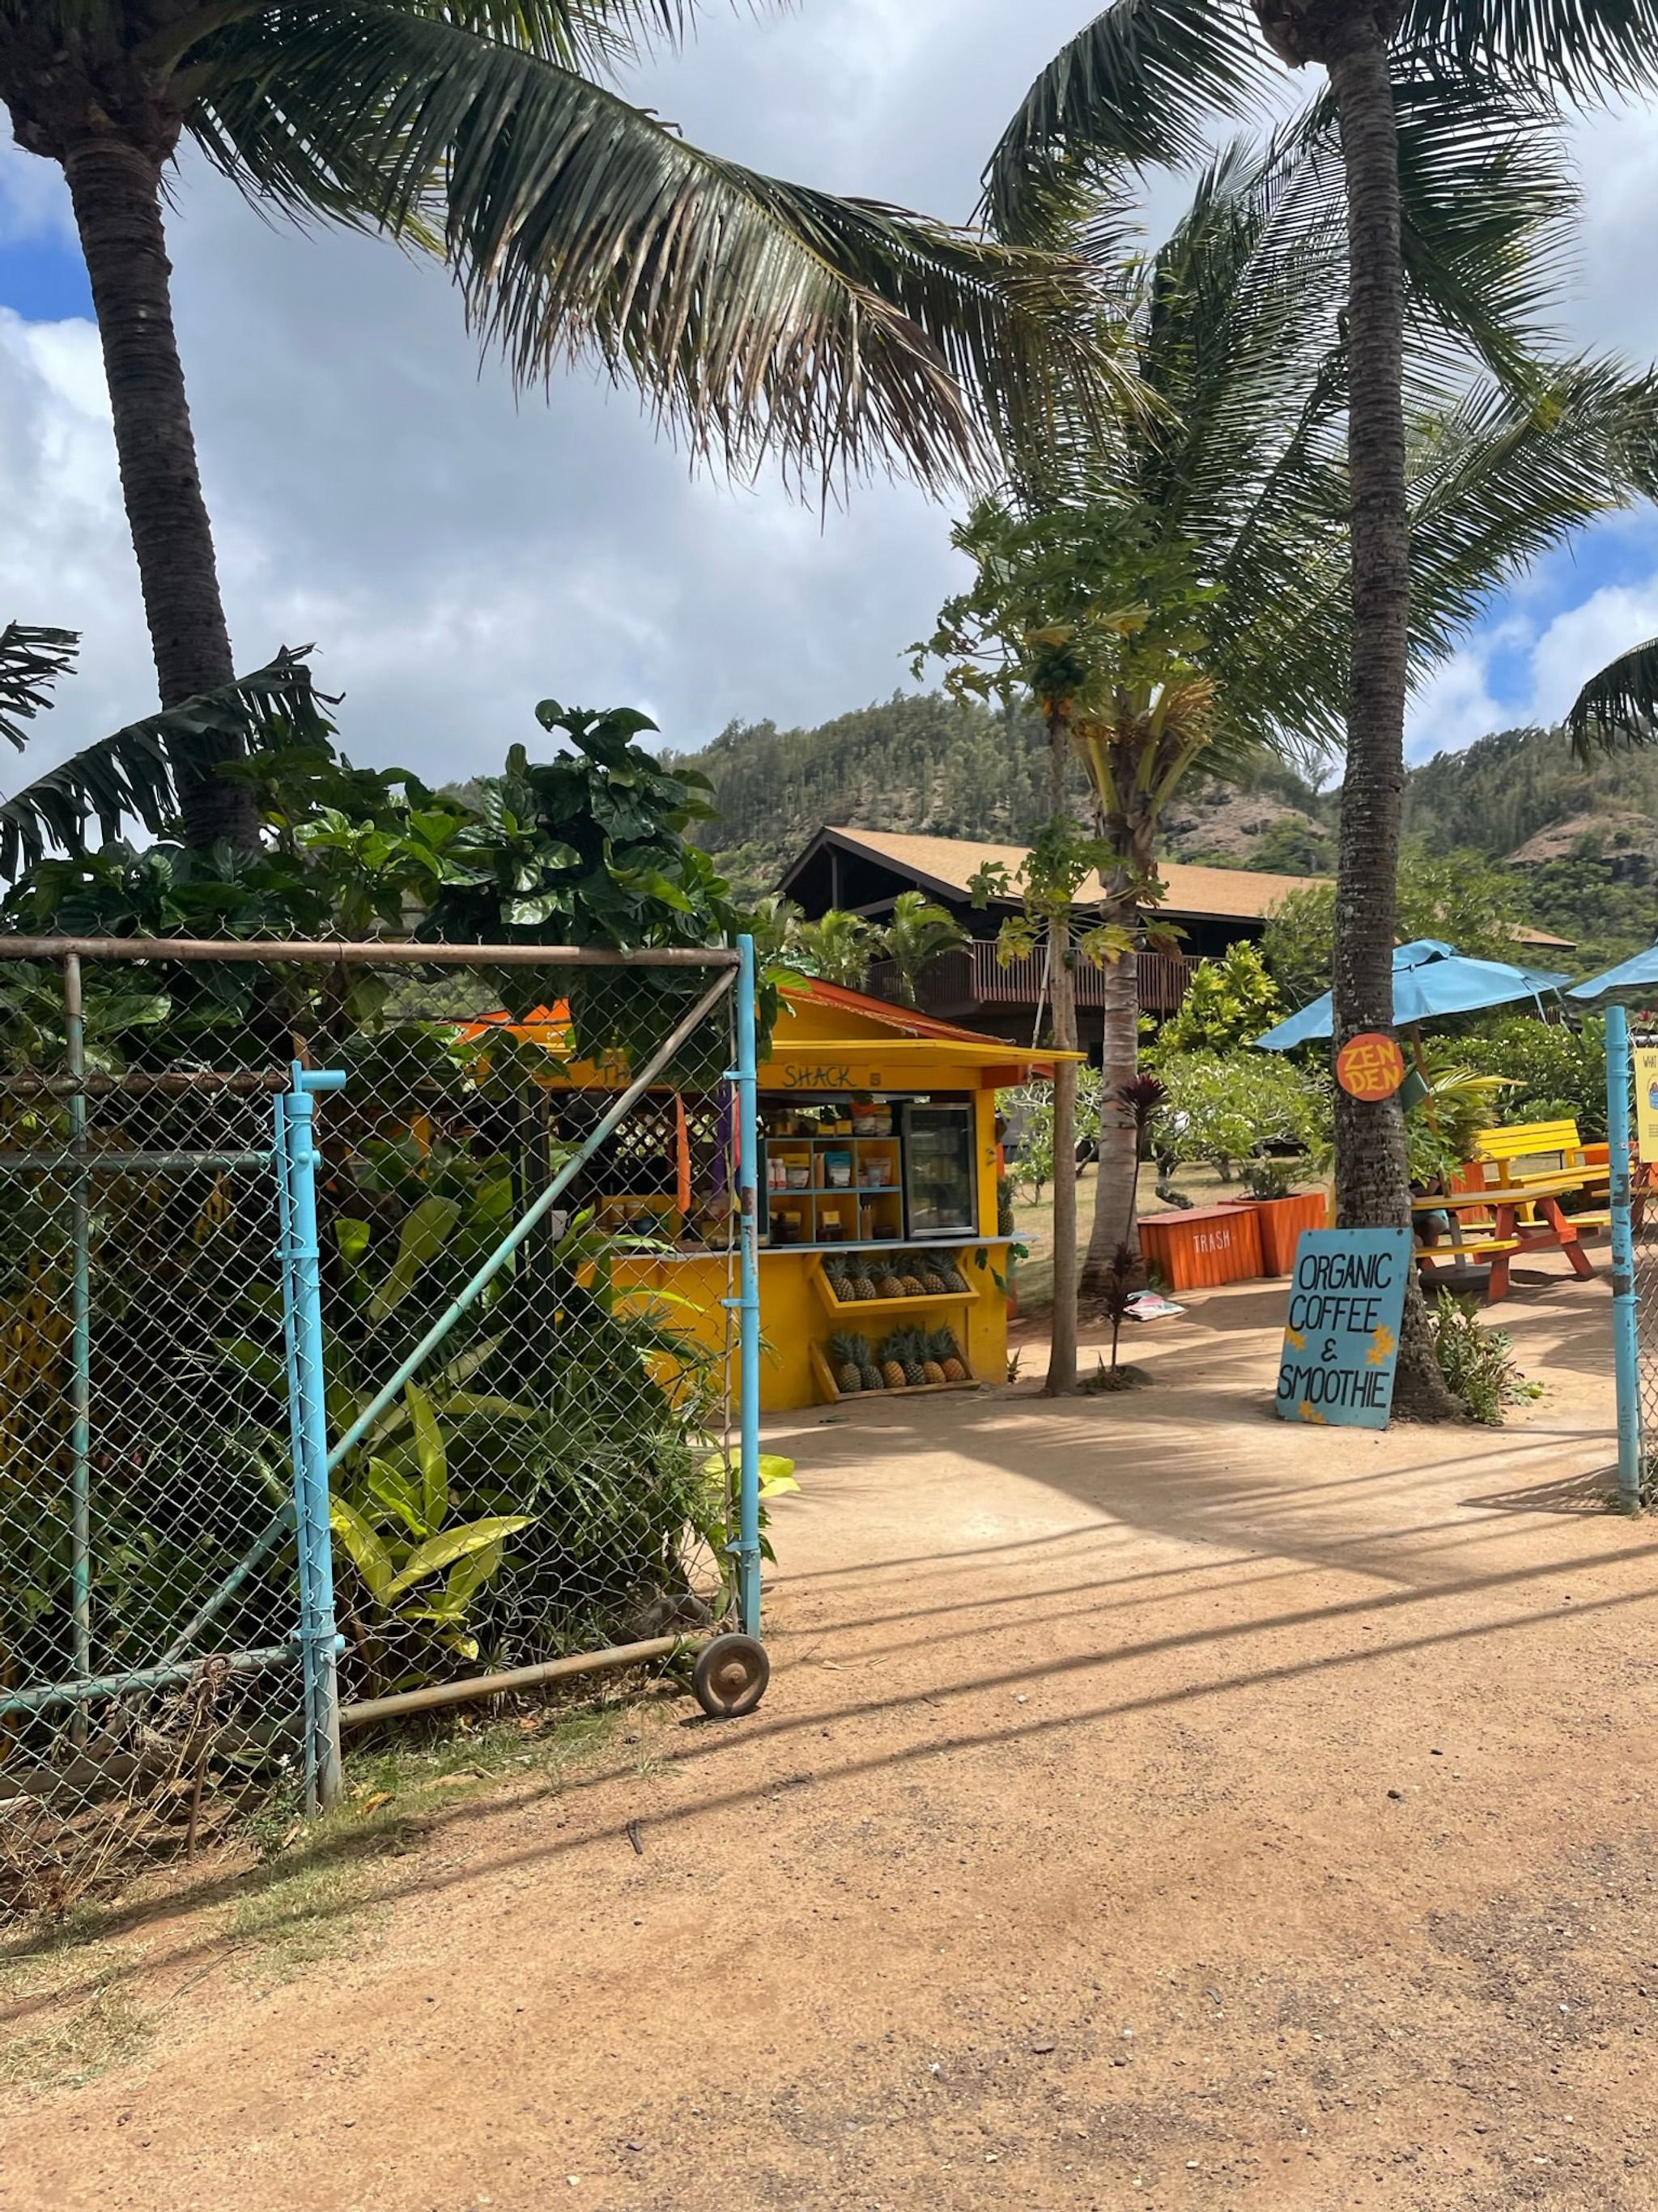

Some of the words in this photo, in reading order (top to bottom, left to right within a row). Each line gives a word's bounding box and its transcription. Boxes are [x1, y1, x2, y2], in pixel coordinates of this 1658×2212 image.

[1342, 1040, 1396, 1070] ZEN
[782, 1065, 858, 1087] SHACK
[1346, 1066, 1400, 1095] DEN
[1192, 1230, 1231, 1254] TRASH
[1299, 1253, 1392, 1291] ORGANIC
[1289, 1295, 1382, 1334] COFFEE
[1320, 1338, 1338, 1362] &
[1277, 1363, 1391, 1408] SMOOTHIE
